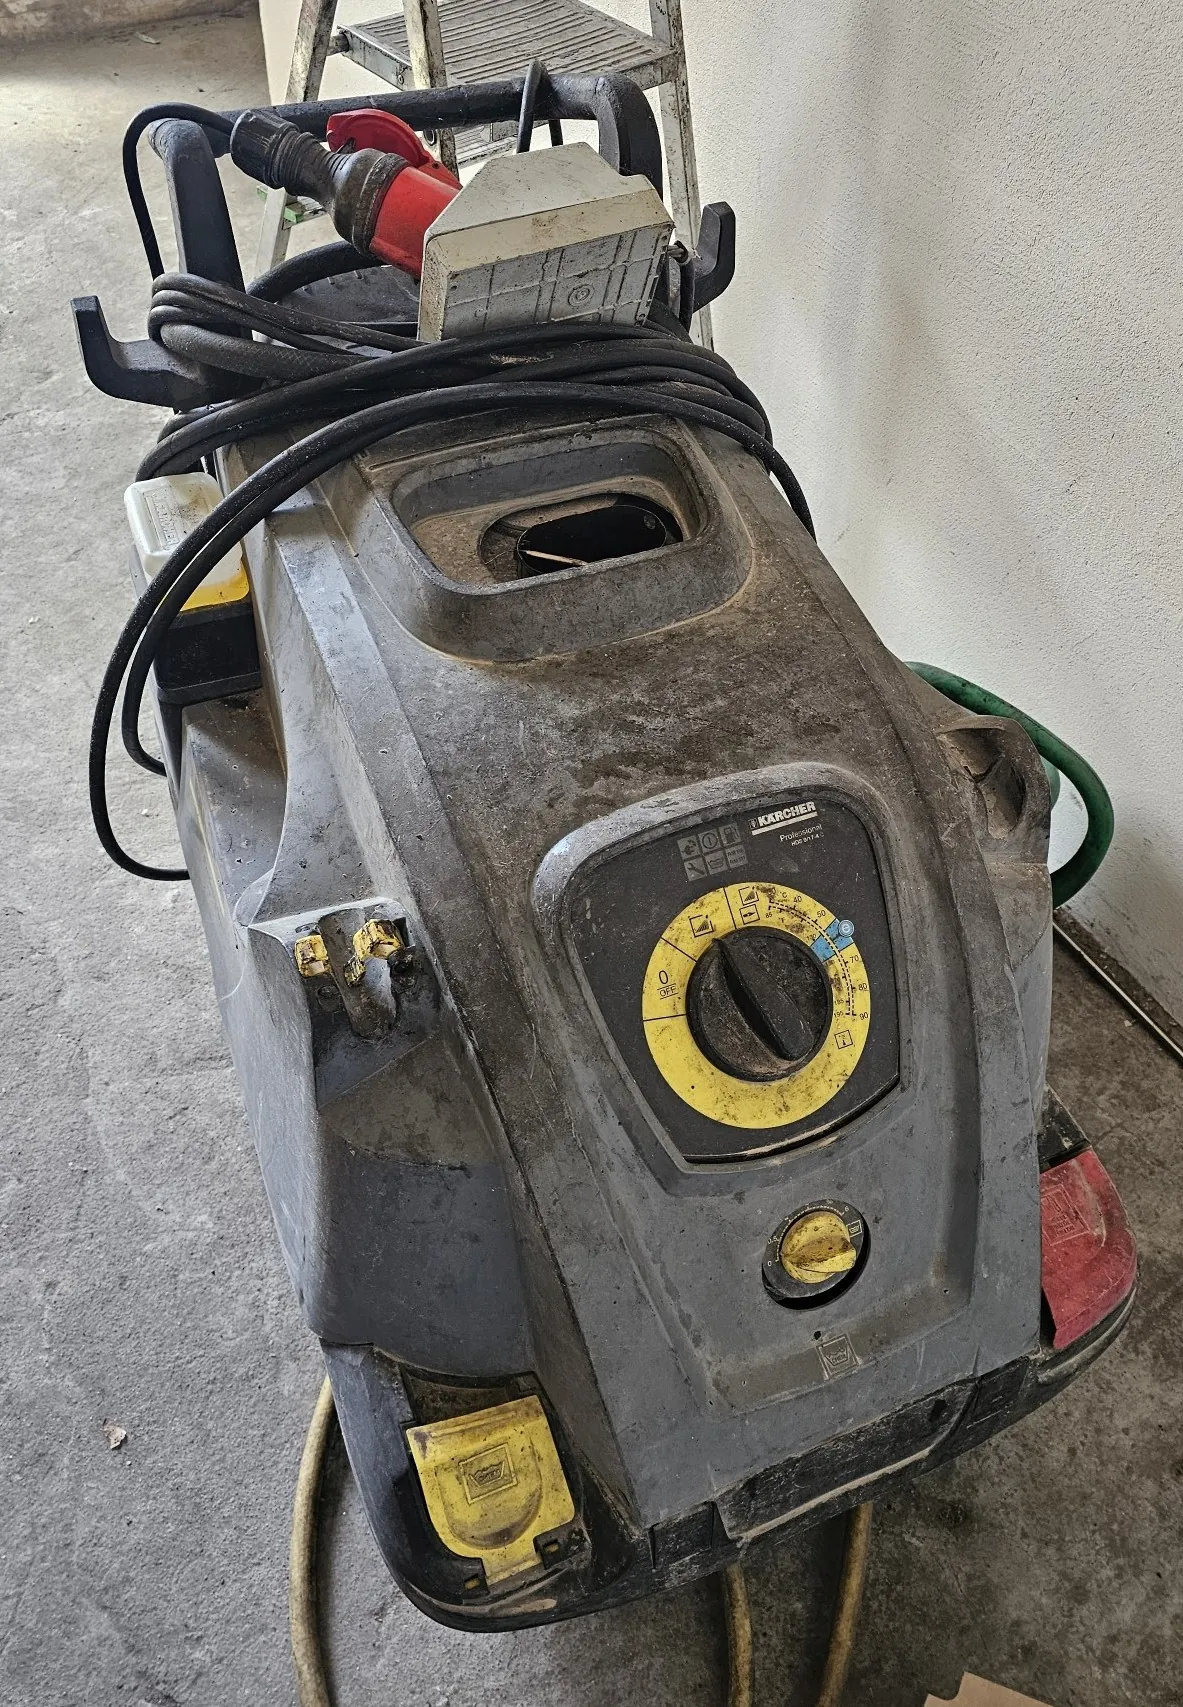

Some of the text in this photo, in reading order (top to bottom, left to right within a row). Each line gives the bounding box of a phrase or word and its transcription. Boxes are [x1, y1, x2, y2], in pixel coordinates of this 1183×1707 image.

[779, 823, 823, 842] Professional
[793, 895, 802, 904] 40
[816, 909, 826, 918] 50
[849, 955, 859, 964] 70
[659, 985, 677, 997] OFF
[858, 982, 868, 992] 80
[859, 1011, 869, 1020] 90
[767, 1235, 778, 1245] 0.5
